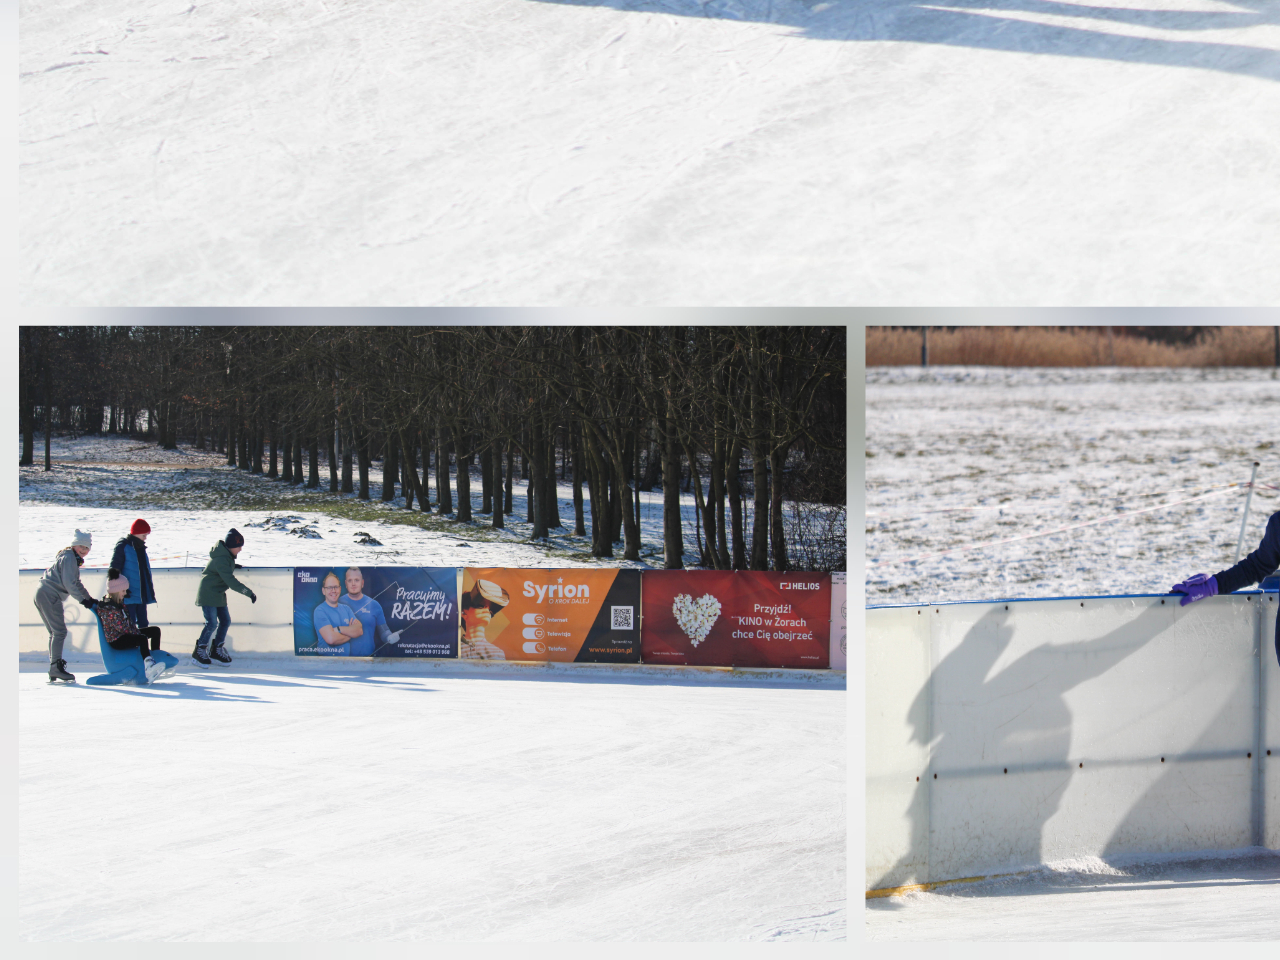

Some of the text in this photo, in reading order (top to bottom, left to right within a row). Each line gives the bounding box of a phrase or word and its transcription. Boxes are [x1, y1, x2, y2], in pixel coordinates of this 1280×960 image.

[396, 587, 445, 607] Pracujmy
[523, 577, 590, 603] Syrion
[391, 601, 452, 621] RAZEM!
[754, 604, 792, 615] Przyjdź!
[738, 616, 762, 626] KINO
[775, 615, 806, 627] Żorach
[732, 630, 813, 641] chce Cię obejrzeć
